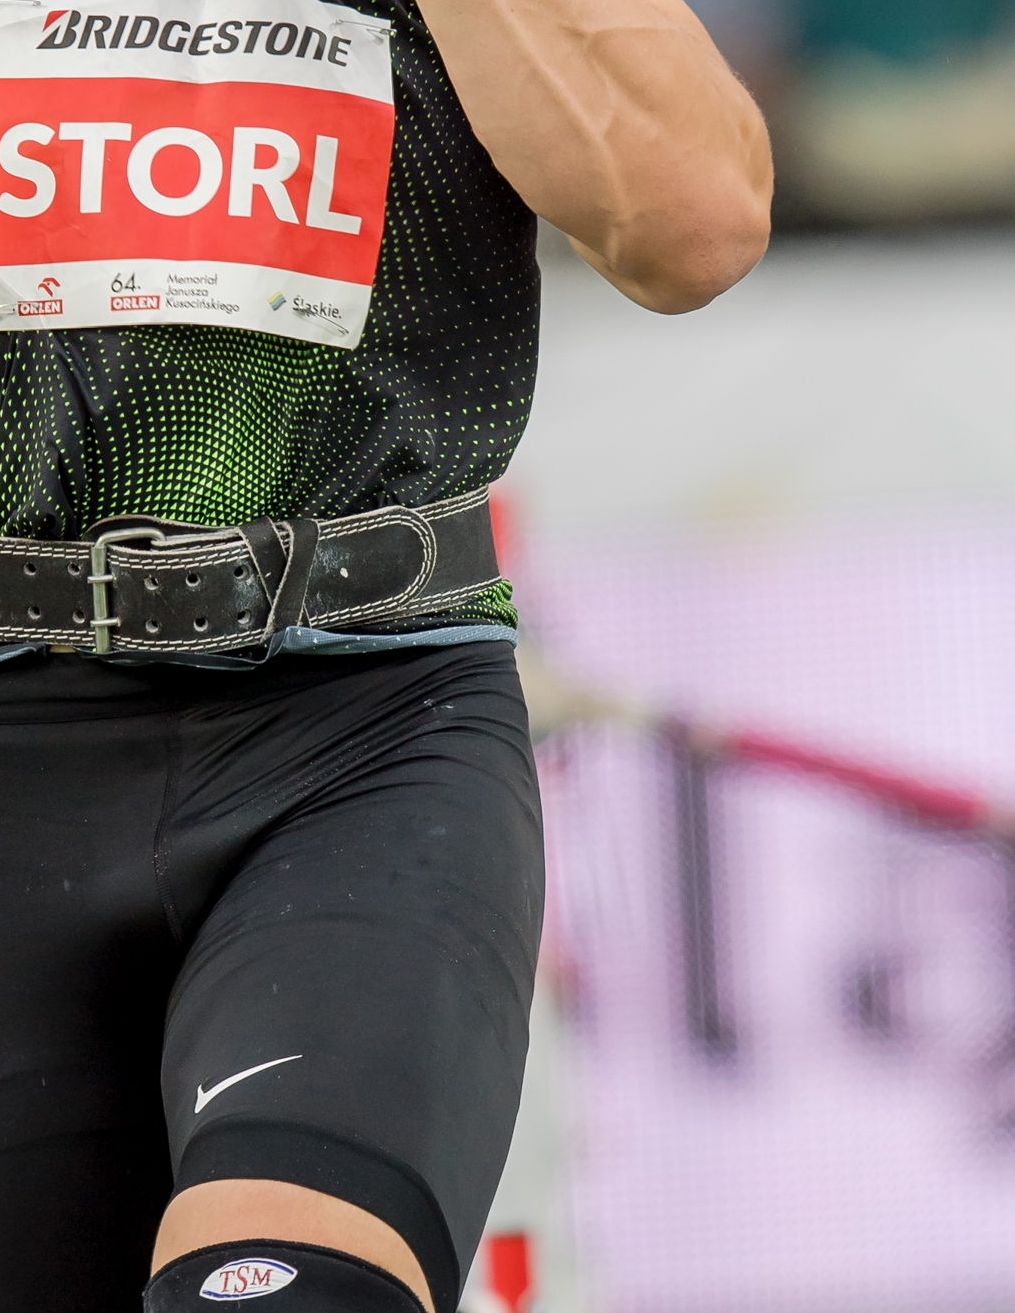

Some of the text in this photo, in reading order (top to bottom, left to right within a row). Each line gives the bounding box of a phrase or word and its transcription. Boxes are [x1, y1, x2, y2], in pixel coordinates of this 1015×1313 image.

[36, 10, 351, 67] BRIDGESTONE
[110, 271, 142, 293] 64.
[165, 285, 209, 297] Janusza
[19, 300, 61, 315] ORLEN
[112, 296, 157, 310] ORLEN
[219, 1265, 273, 1294] TSM
